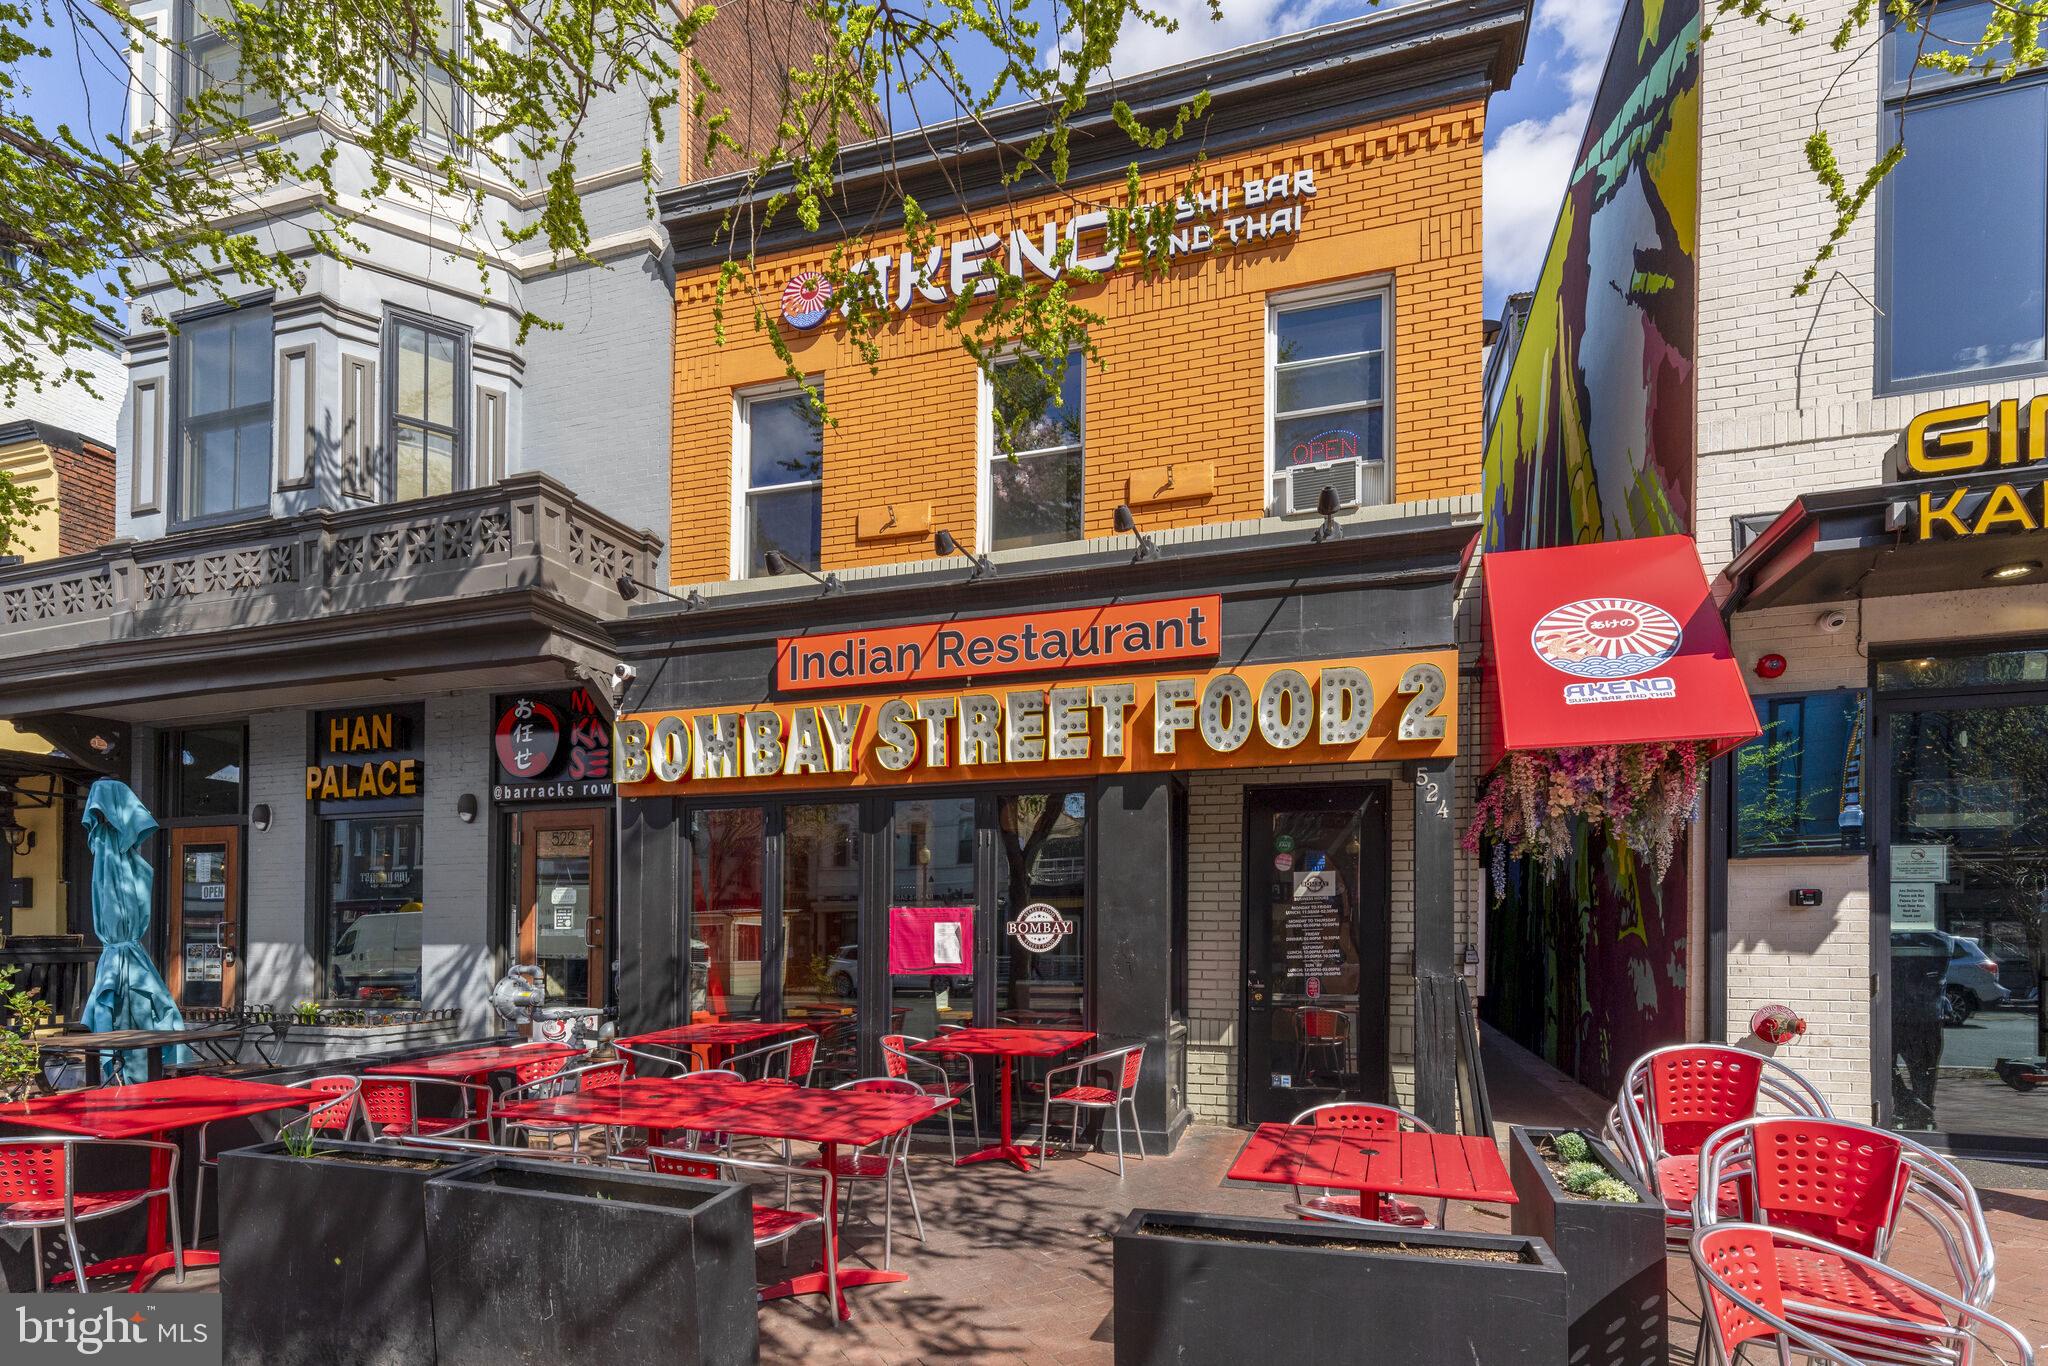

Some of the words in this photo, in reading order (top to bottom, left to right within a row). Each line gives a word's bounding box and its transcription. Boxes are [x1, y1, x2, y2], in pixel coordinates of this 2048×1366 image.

[1130, 187, 1230, 229] SSHI
[1243, 168, 1317, 206] BAR
[1223, 206, 1302, 245] THAI
[1293, 436, 1357, 465] OPEN
[1919, 480, 2048, 540] KA
[789, 637, 921, 681] Indian
[936, 606, 1208, 669] Restaurant
[1590, 618, 1636, 630] あけの
[1566, 678, 1673, 698] AKENO
[330, 713, 393, 752] HAN
[514, 698, 535, 770] お任せ
[613, 703, 868, 784] BOMBAY
[876, 683, 1136, 770] STREET
[1154, 666, 1375, 754] FOOD
[1398, 662, 1448, 741] 2
[306, 759, 417, 800] PALACE
[493, 783, 574, 800] @barracks
[583, 783, 611, 796] row
[1416, 767, 1449, 819] 524
[551, 831, 577, 847] 522
[203, 886, 224, 898] OPEN
[1009, 922, 1070, 934] BOMBAY
